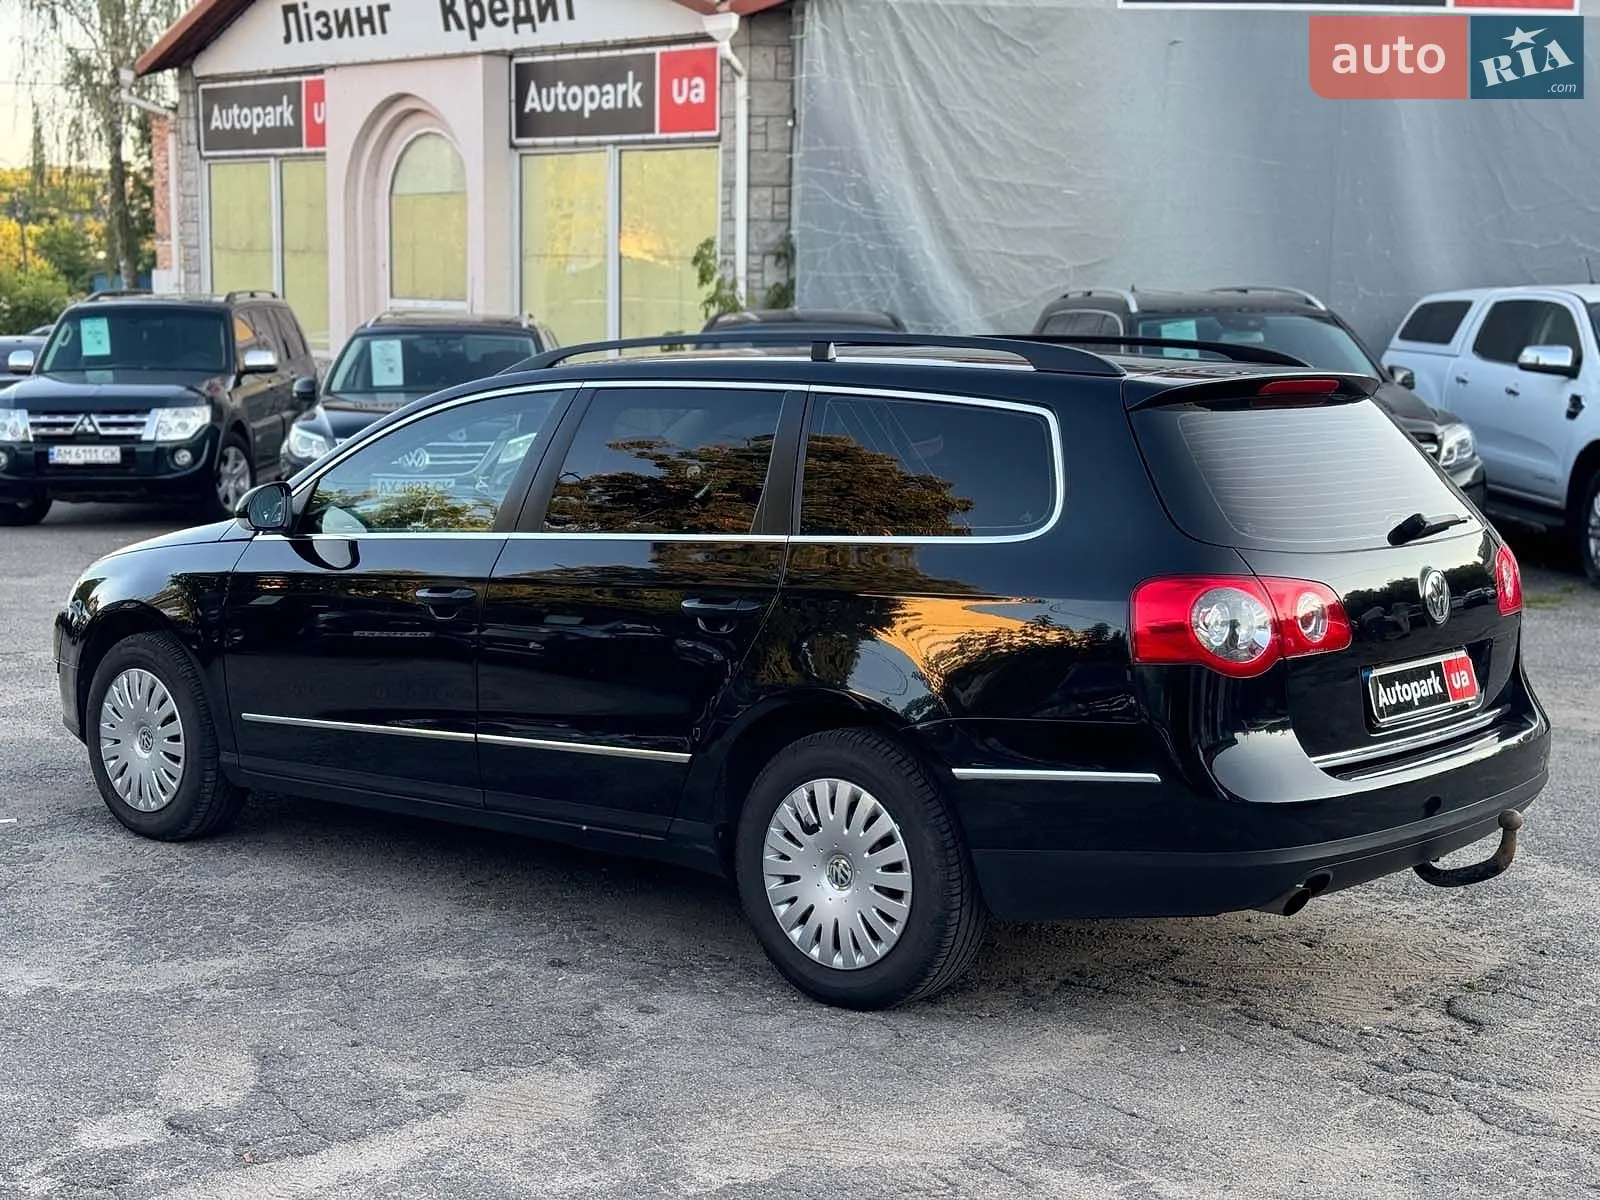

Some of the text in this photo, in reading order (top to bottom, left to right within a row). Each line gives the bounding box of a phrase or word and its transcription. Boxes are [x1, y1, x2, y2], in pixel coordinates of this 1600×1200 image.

[281, 2, 392, 45] Лізинг
[210, 93, 295, 136] Autopark
[524, 70, 706, 119] Autopark ua
[1378, 669, 1471, 708] Autopark ua
